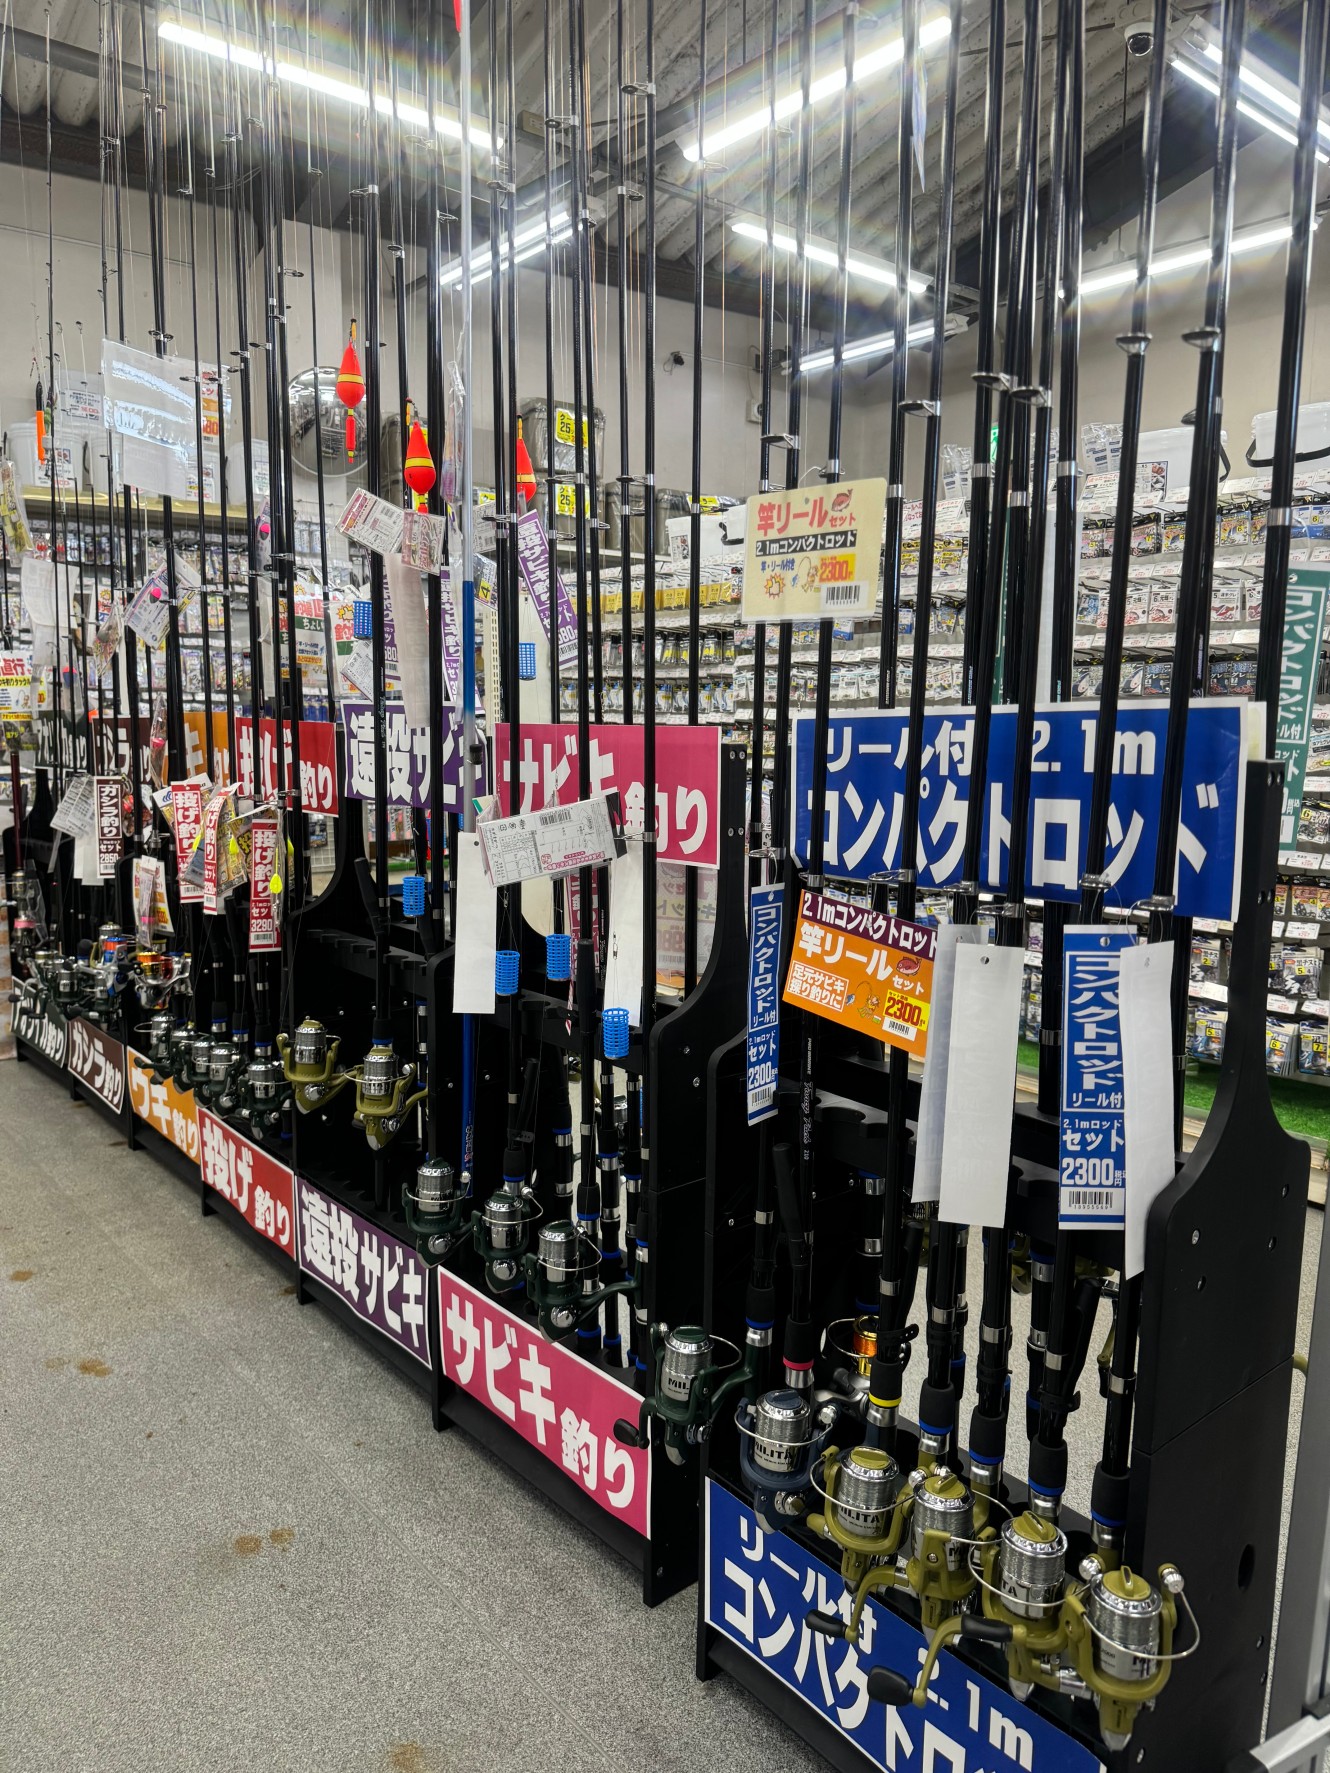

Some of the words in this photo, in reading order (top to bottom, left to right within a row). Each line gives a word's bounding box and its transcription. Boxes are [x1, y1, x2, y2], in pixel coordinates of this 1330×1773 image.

[560, 421, 571, 434] 25
[560, 494, 571, 506] 25
[757, 497, 829, 537] 竿リール
[829, 512, 857, 528] セット
[819, 560, 849, 582] 2300
[826, 719, 975, 777] リール付
[1028, 718, 1158, 776] 2.1m
[100, 785, 119, 838] ガシラ釣り
[174, 792, 201, 855] 投げ釣り
[253, 831, 277, 898] 投げ釣り
[806, 778, 1219, 906] コンパクトロッド
[251, 919, 272, 932] 3290
[755, 909, 778, 1013] コンパクトロッド
[793, 964, 846, 994] 足元サビキ
[798, 922, 893, 982] 竿リール
[891, 975, 925, 996] セット
[753, 1009, 776, 1027] リール付
[884, 996, 922, 1027] 2300
[1069, 956, 1124, 1091] コンパクトロッド
[72, 1021, 122, 1105] ガシラ釣り
[749, 1039, 777, 1063] セット
[748, 1061, 772, 1090] 2300
[131, 1066, 199, 1159] ウキ釣り
[1062, 1118, 1122, 1129] 2.1mロッド
[1071, 1092, 1122, 1109] リール付
[1062, 1129, 1125, 1153] セット
[203, 1117, 291, 1247] 投げ釣り
[1061, 1157, 1115, 1186] 2300
[301, 1185, 425, 1348] 遠投サビキ
[447, 1293, 636, 1509] サビキ釣り
[740, 1516, 878, 1656] リール付
